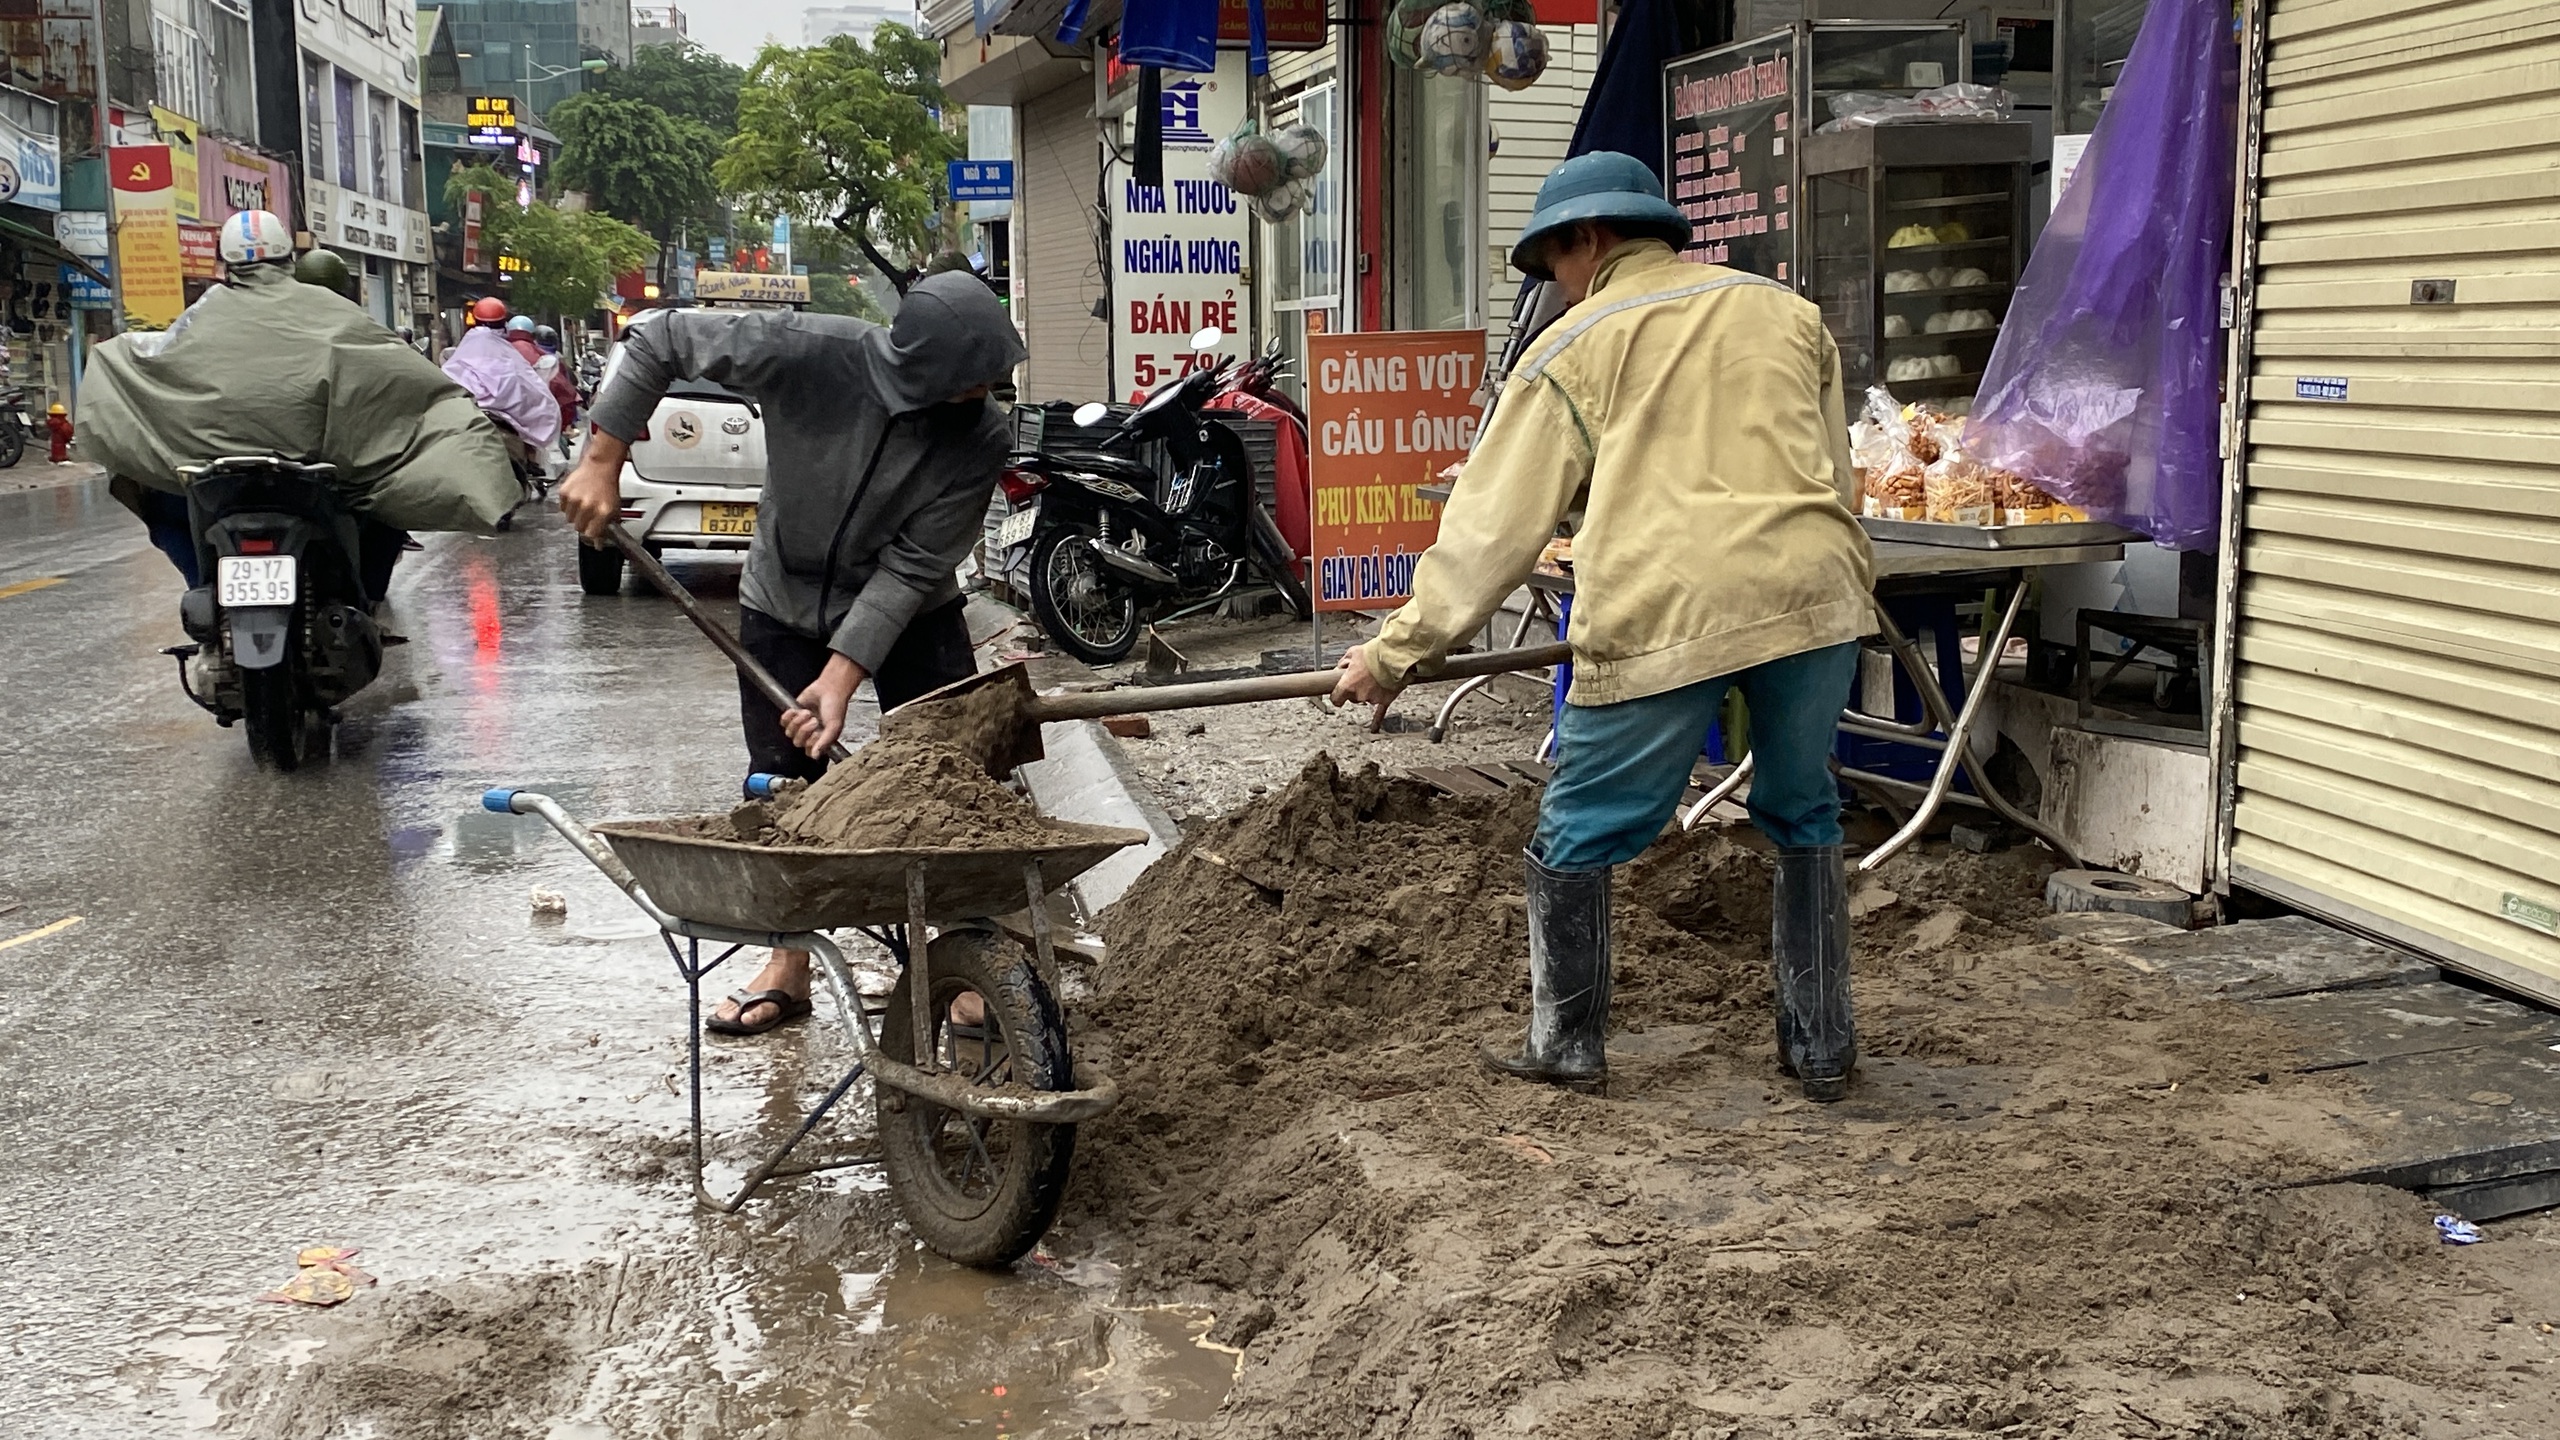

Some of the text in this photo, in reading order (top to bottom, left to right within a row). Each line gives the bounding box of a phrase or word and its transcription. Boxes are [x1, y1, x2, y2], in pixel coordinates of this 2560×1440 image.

[1706, 73, 1731, 112] BAO
[1124, 233, 1241, 275] NGHĨA HƯNG
[760, 276, 796, 290] TAXI
[1131, 288, 1238, 335] BÁN RẺ
[1320, 350, 1475, 398] CĂNG VỢT
[1321, 407, 1477, 457] CẦU LÔNG
[1317, 459, 1434, 536] PHỤ KIỆN THỂ
[225, 580, 290, 602] 355.95
[231, 559, 283, 581] 29-Y7
[1321, 546, 1358, 602] GIÀY
[1360, 544, 1382, 599] ĐÁ
